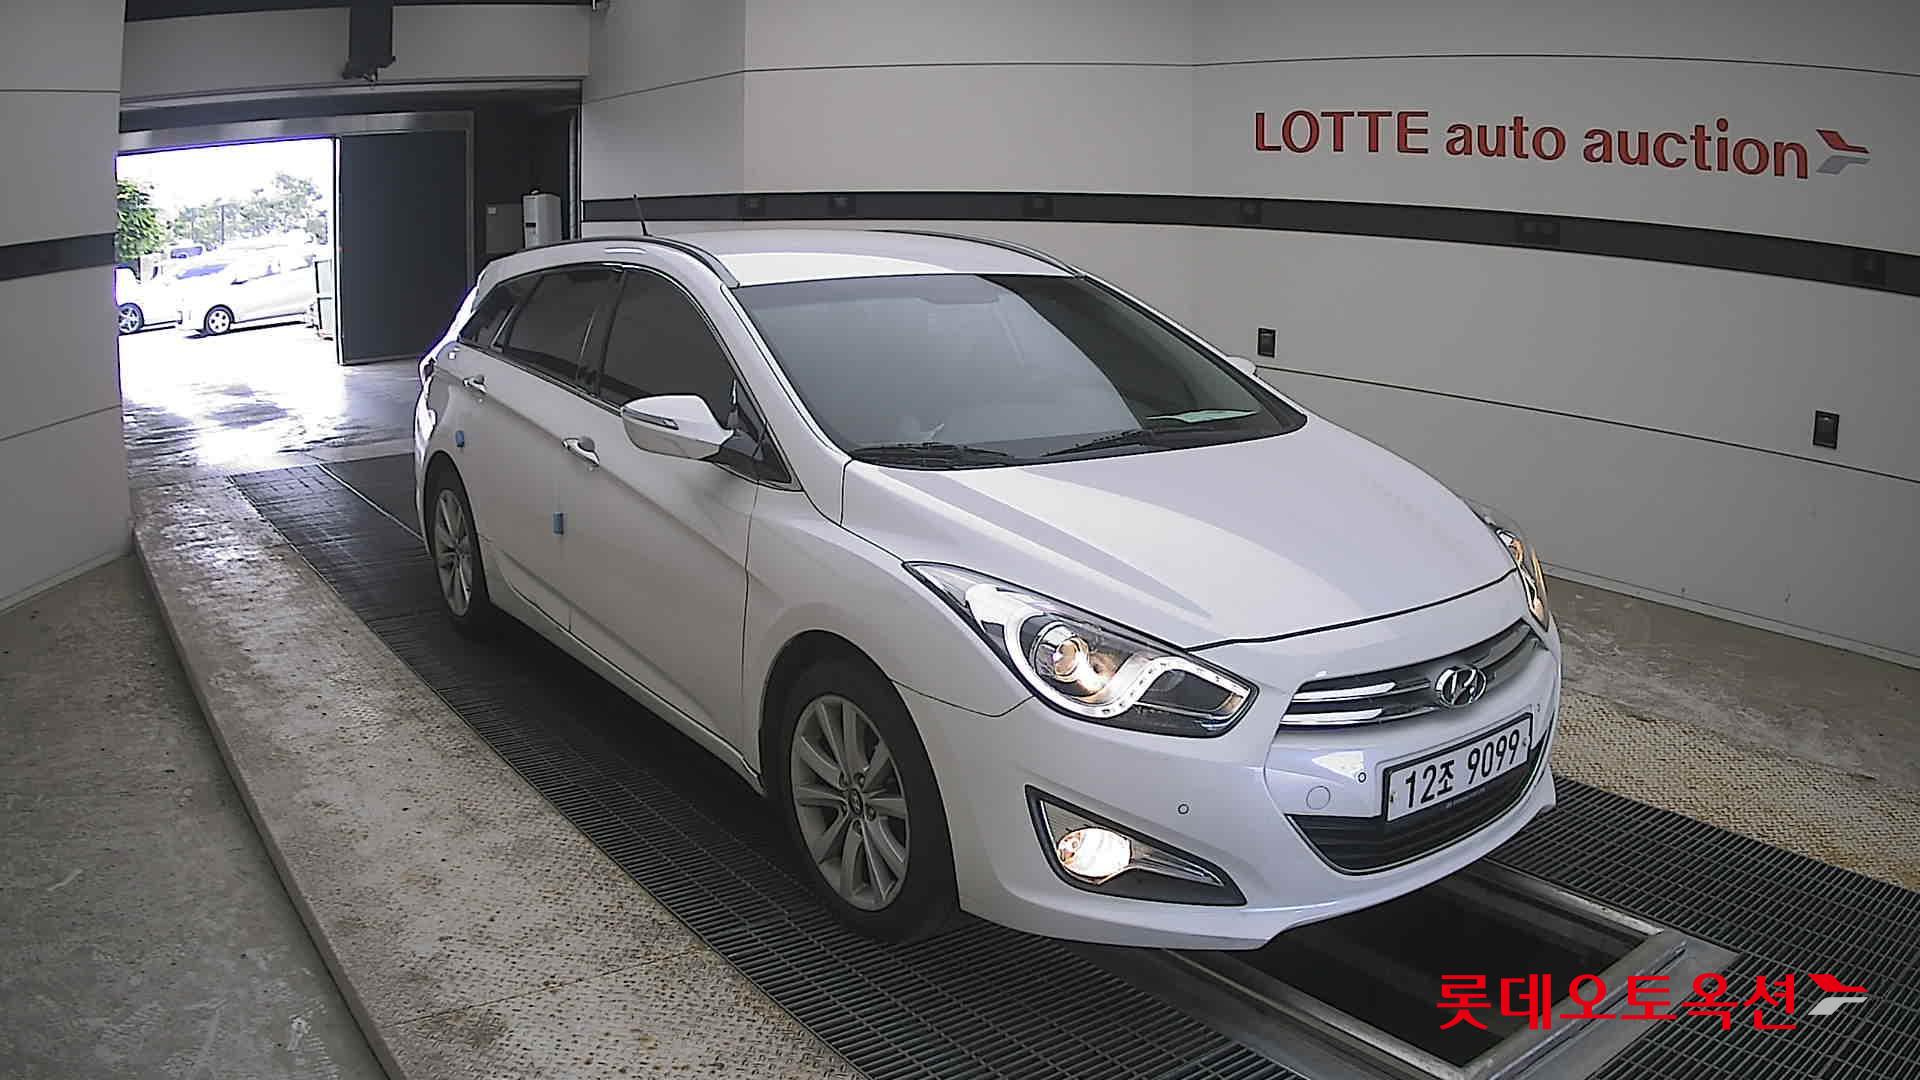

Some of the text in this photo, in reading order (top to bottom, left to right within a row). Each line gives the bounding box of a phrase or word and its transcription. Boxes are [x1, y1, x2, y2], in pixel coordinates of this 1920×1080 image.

[1255, 110, 1809, 180] LOTTE auto auction
[1405, 760, 1455, 809] 12조
[1467, 729, 1521, 785] 9099
